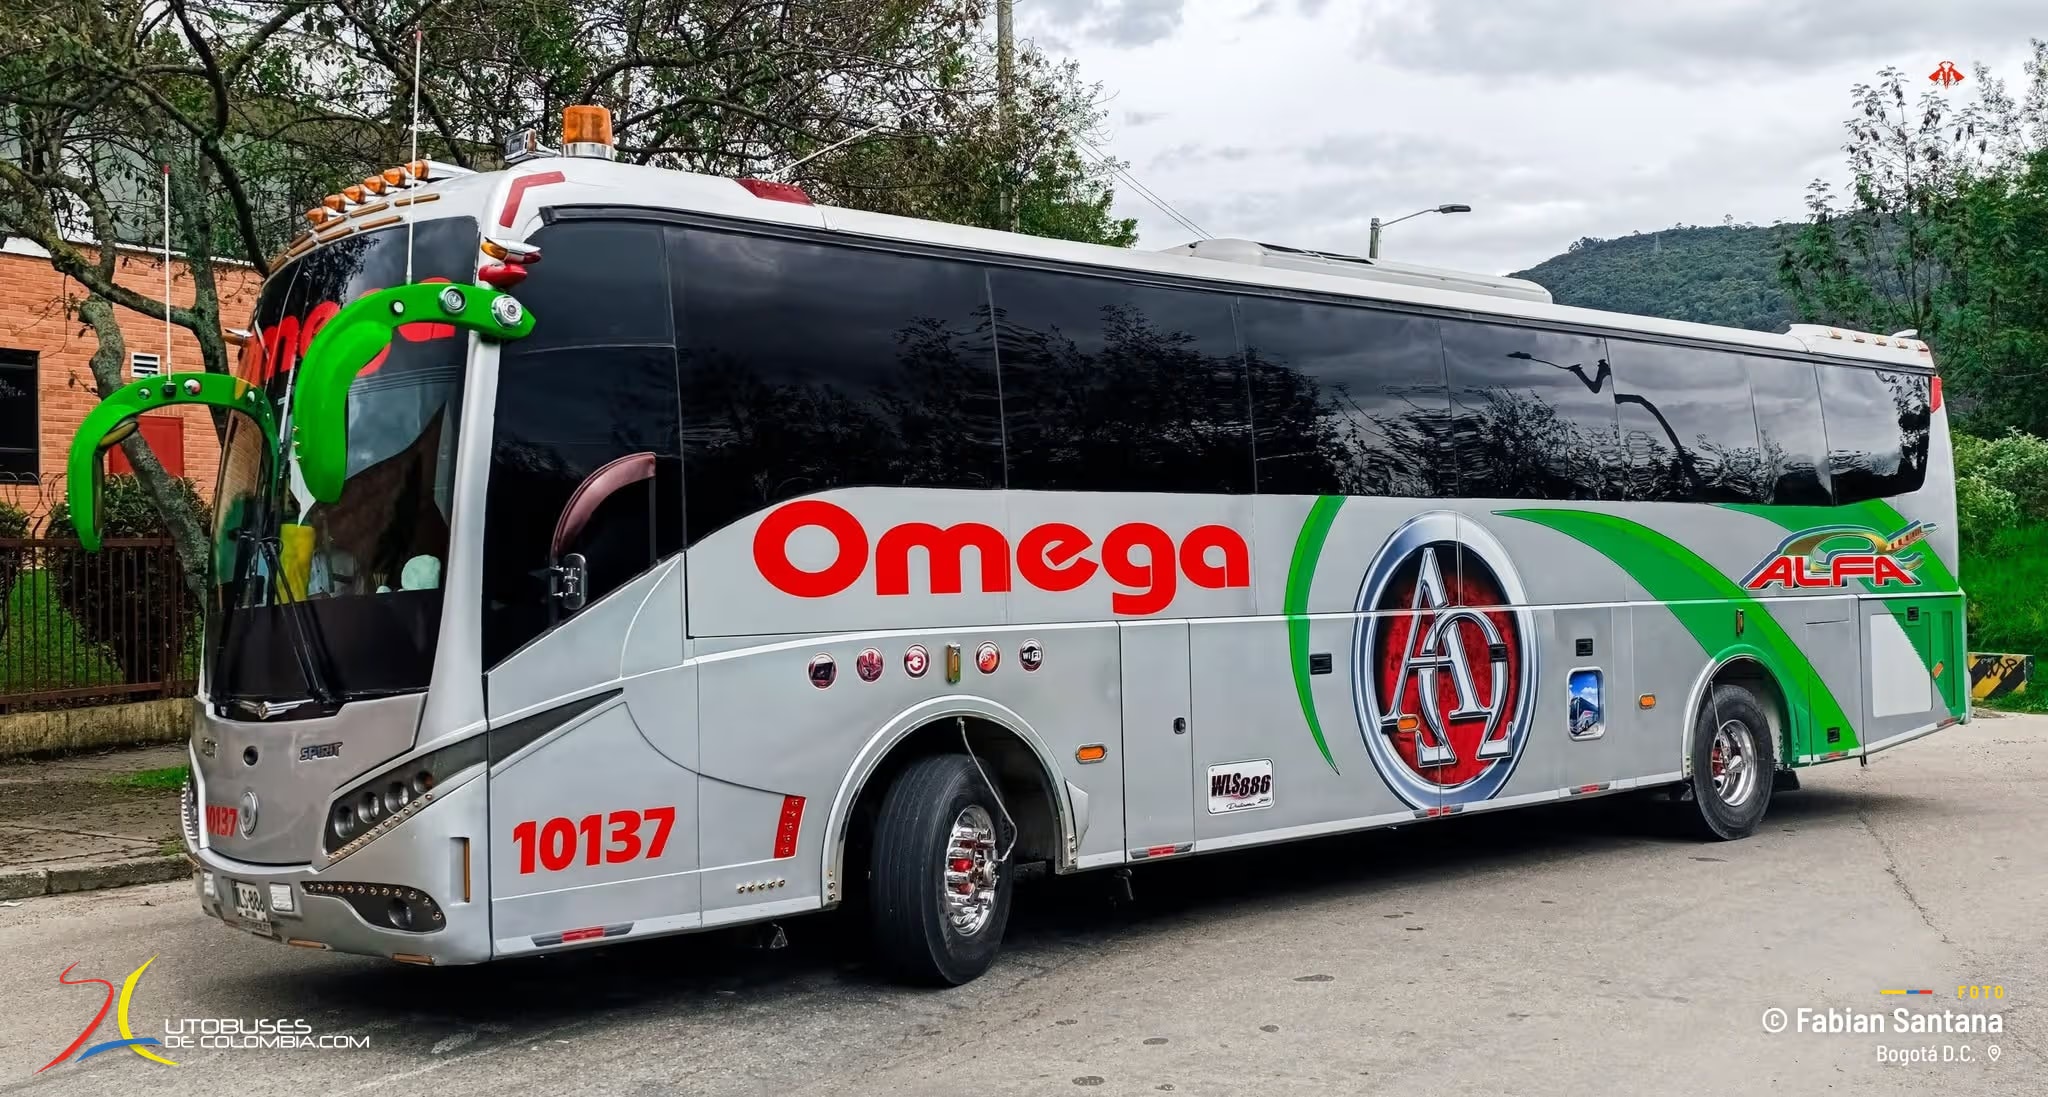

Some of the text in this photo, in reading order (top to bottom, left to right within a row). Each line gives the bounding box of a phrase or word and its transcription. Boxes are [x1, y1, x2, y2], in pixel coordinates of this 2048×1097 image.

[753, 500, 1250, 615] Omega
[1746, 556, 1915, 589] ALFA
[299, 742, 344, 761] SPIRIT
[1211, 772, 1271, 798] WLS886
[512, 806, 676, 875] 10137
